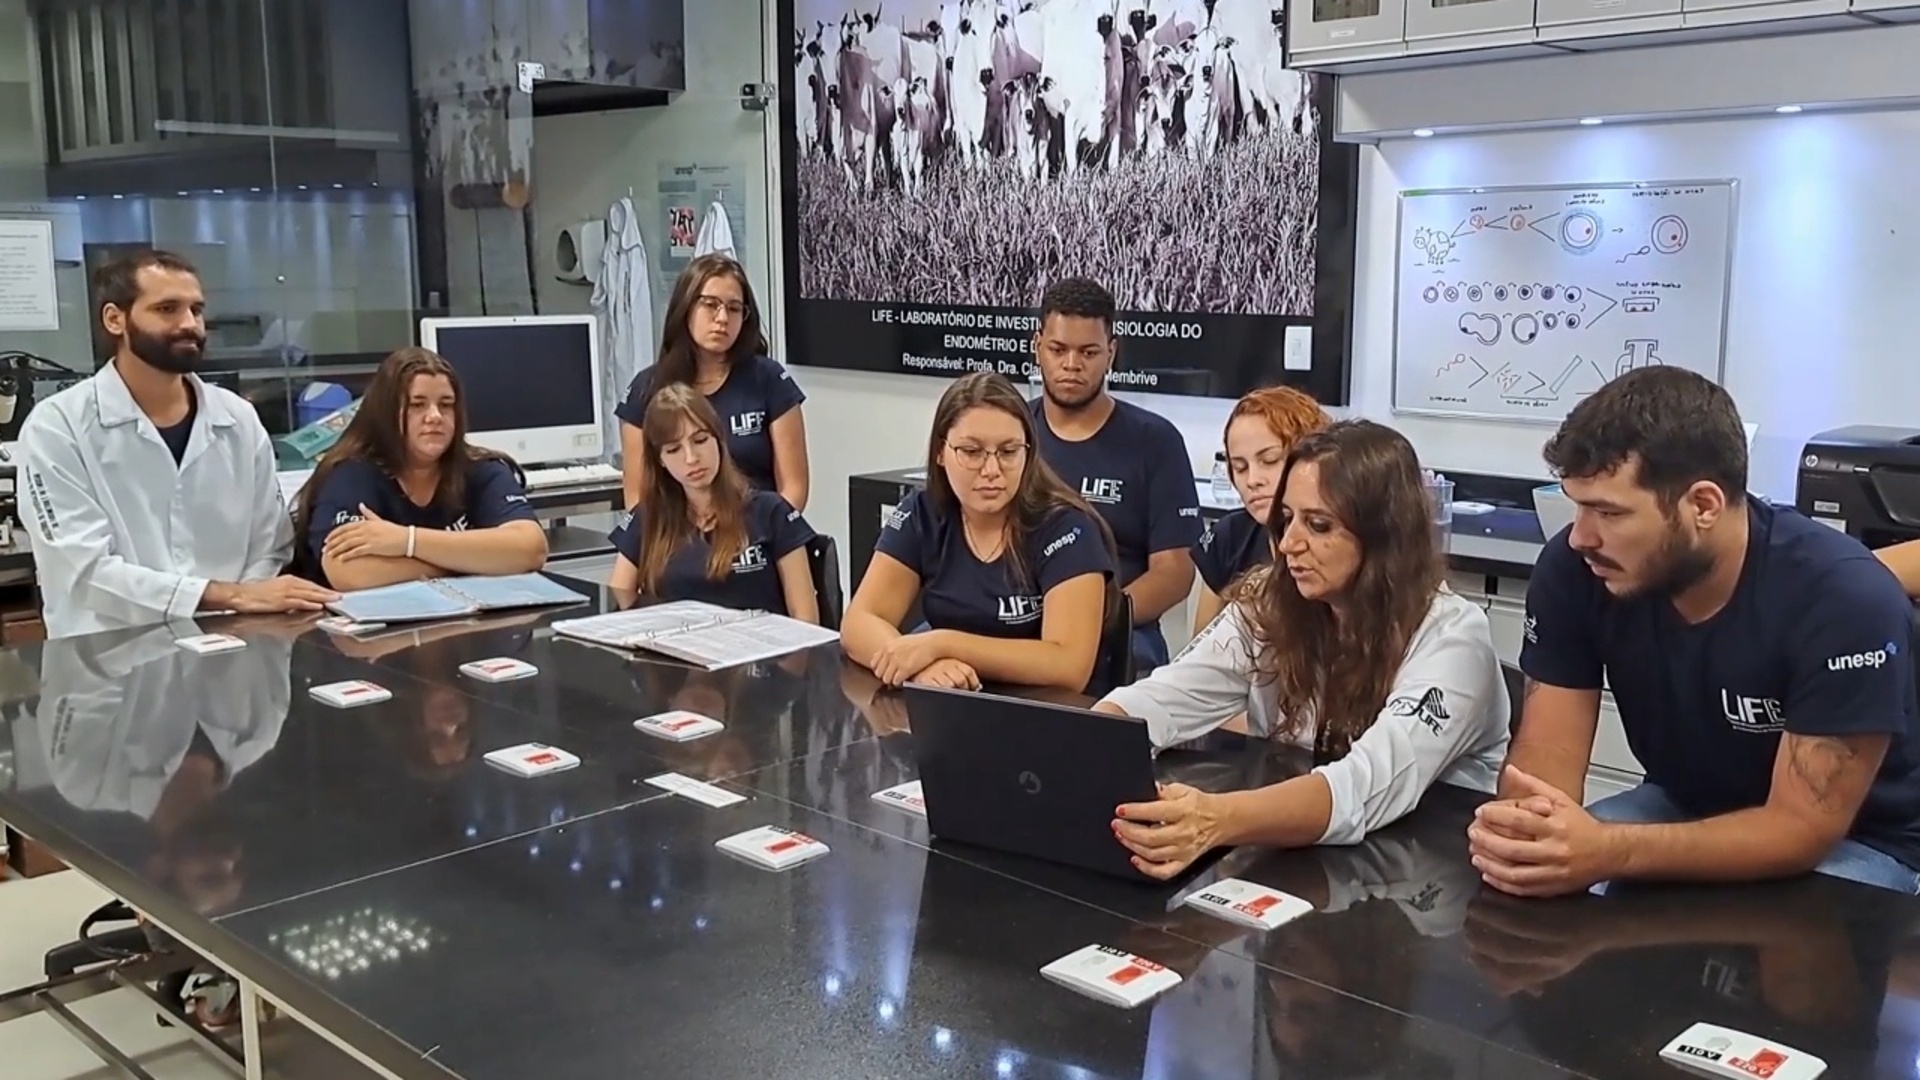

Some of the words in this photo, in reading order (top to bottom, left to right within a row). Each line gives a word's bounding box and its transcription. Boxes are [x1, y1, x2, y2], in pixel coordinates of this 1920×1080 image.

[872, 309, 893, 323] LIFE
[900, 311, 975, 328] LABORATÓRIO
[978, 315, 993, 328] DE
[995, 316, 1042, 331] INVESTI
[1112, 321, 1178, 338] ISIOLOGIA
[1181, 323, 1202, 339] DO
[944, 334, 1017, 352] ENDOMÉTRIO
[1020, 339, 1028, 353] E
[902, 353, 964, 371] Responsável:
[966, 358, 995, 373] Profa.
[998, 361, 1019, 375] Dra.
[1021, 362, 1042, 376] Cla
[1081, 477, 1123, 497] LIFE
[1043, 530, 1077, 557] unesp
[1827, 649, 1887, 671] unesp
[1721, 688, 1786, 724] LIFE
[1418, 708, 1443, 737] LIFE
